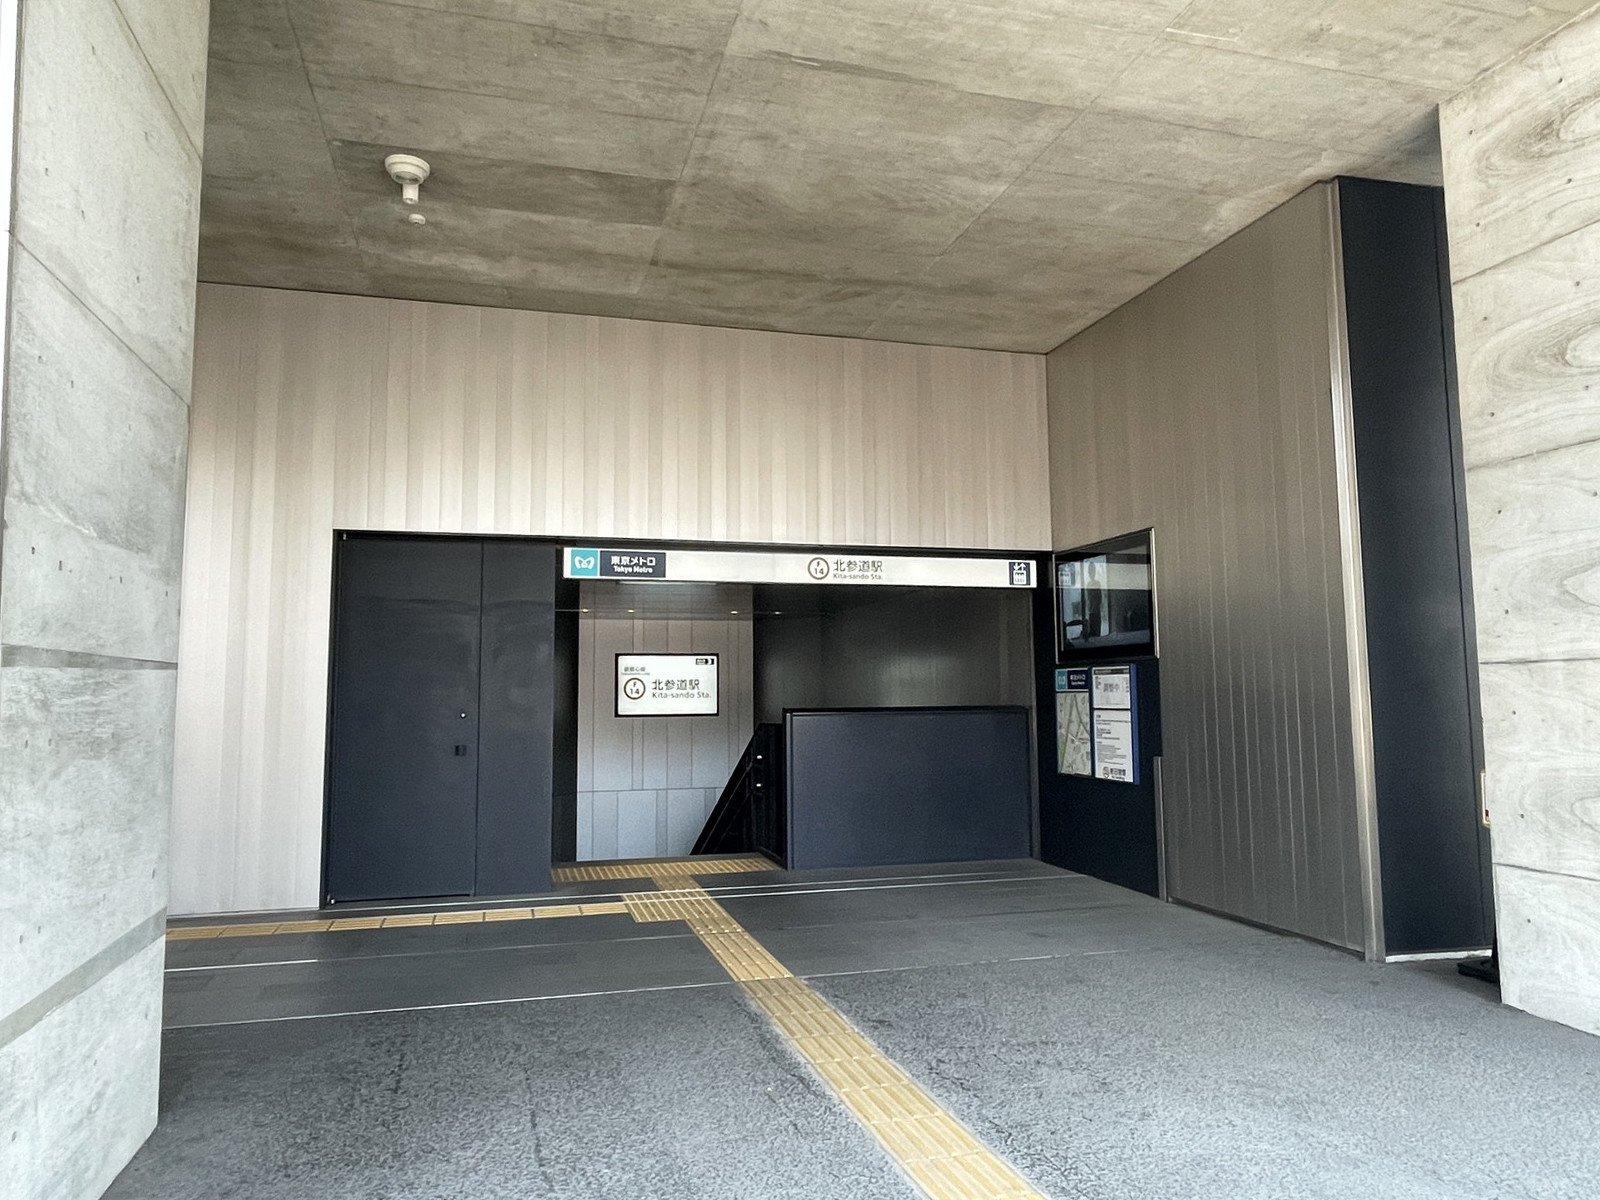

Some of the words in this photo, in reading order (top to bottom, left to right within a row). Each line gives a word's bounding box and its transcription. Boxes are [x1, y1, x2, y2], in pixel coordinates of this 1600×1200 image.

[611, 556, 656, 566] 東京メトロ
[613, 565, 632, 574] Tokyo
[633, 565, 653, 574] Metro
[833, 559, 883, 573] 北参道駅
[814, 567, 825, 575] 14
[652, 679, 700, 691] 北参道駅
[652, 691, 695, 699] Kita-sando
[697, 691, 712, 699] Sta.
